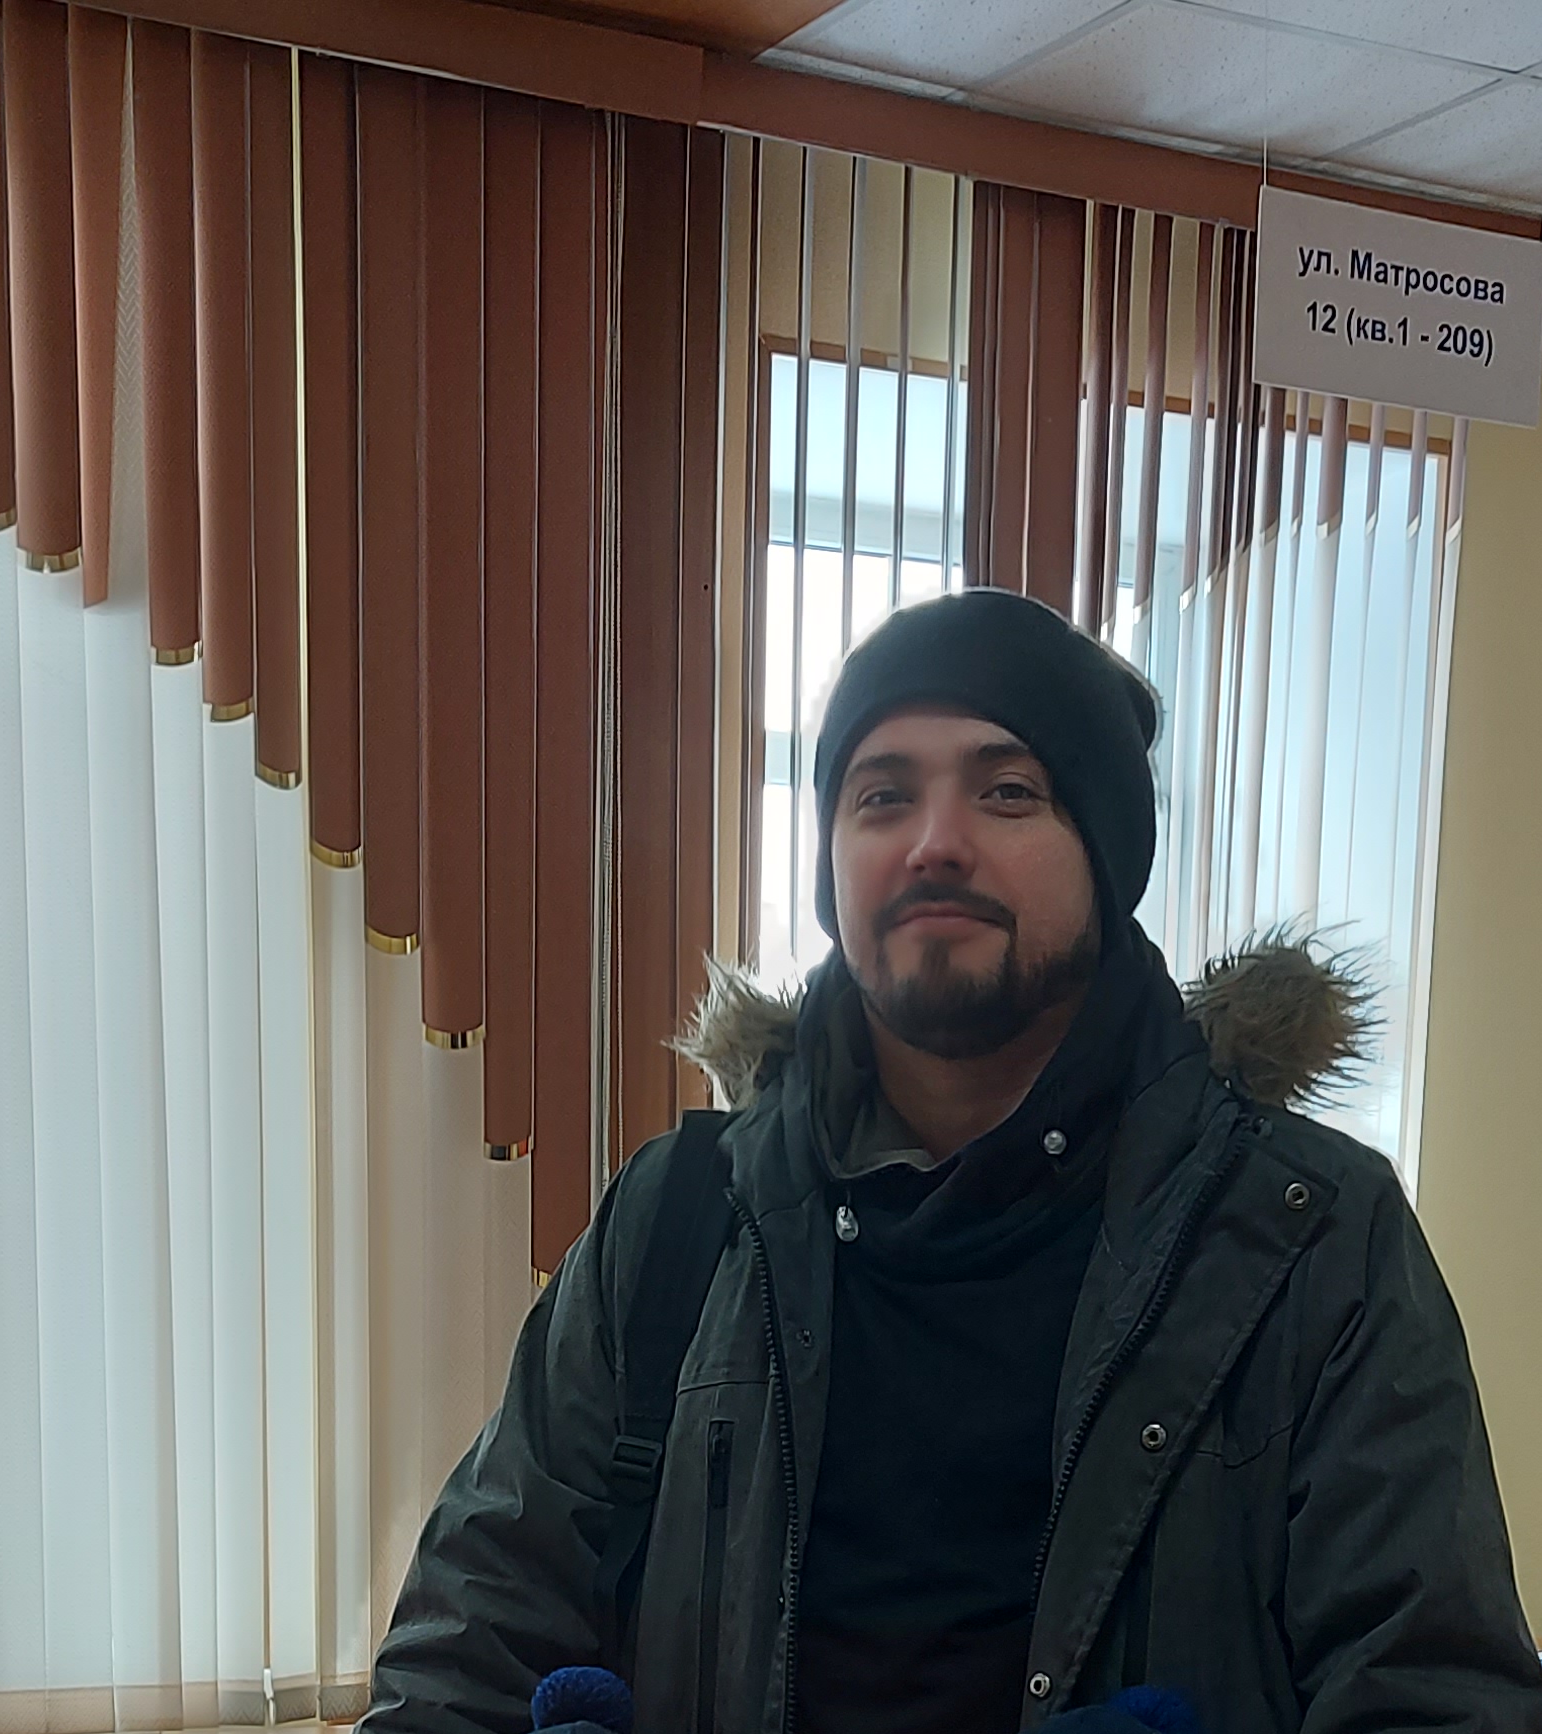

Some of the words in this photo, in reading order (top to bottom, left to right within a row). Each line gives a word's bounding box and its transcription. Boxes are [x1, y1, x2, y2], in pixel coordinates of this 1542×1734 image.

[1297, 246, 1340, 278] ул.
[1349, 249, 1506, 305] Матросова
[1306, 301, 1338, 335] 12
[1346, 307, 1410, 347] (кв.1
[1436, 323, 1495, 368] 209)
